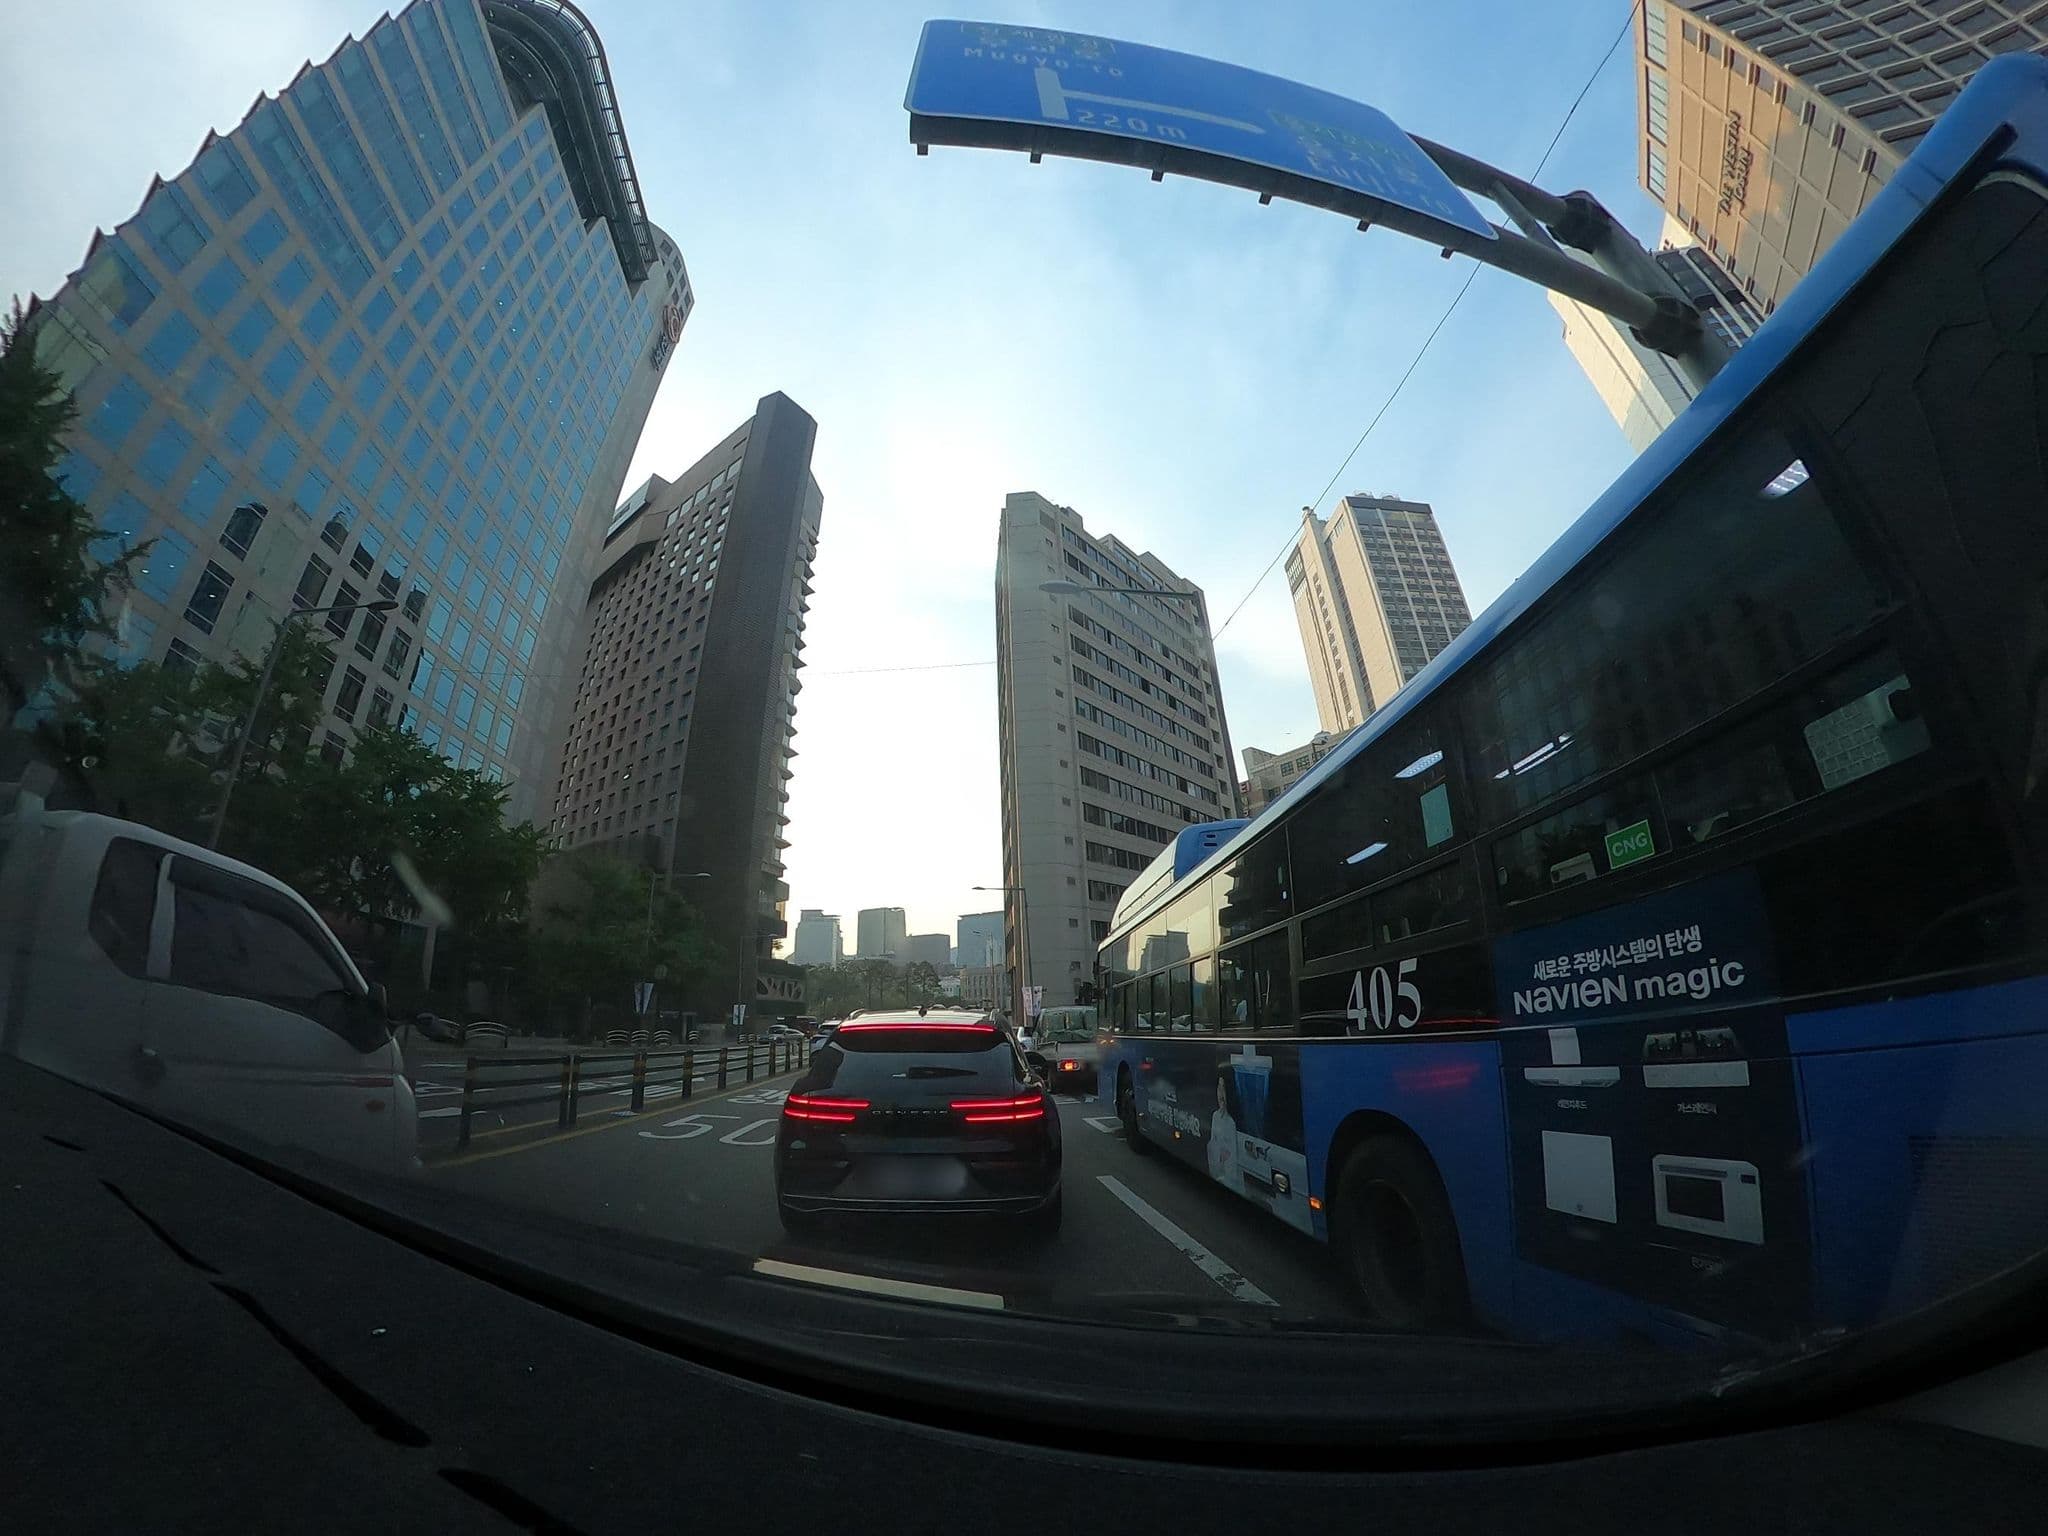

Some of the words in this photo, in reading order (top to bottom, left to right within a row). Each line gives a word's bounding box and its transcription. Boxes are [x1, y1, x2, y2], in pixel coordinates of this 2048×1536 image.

[964, 47, 1123, 77] Mugyo-ro
[1612, 832, 1648, 857] CNG
[1533, 955, 1572, 981] 새로운
[1573, 934, 1664, 975] 주방시스템의
[1665, 924, 1703, 957] 탄생
[1346, 958, 1422, 1033] 405
[1634, 957, 1745, 1000] magic
